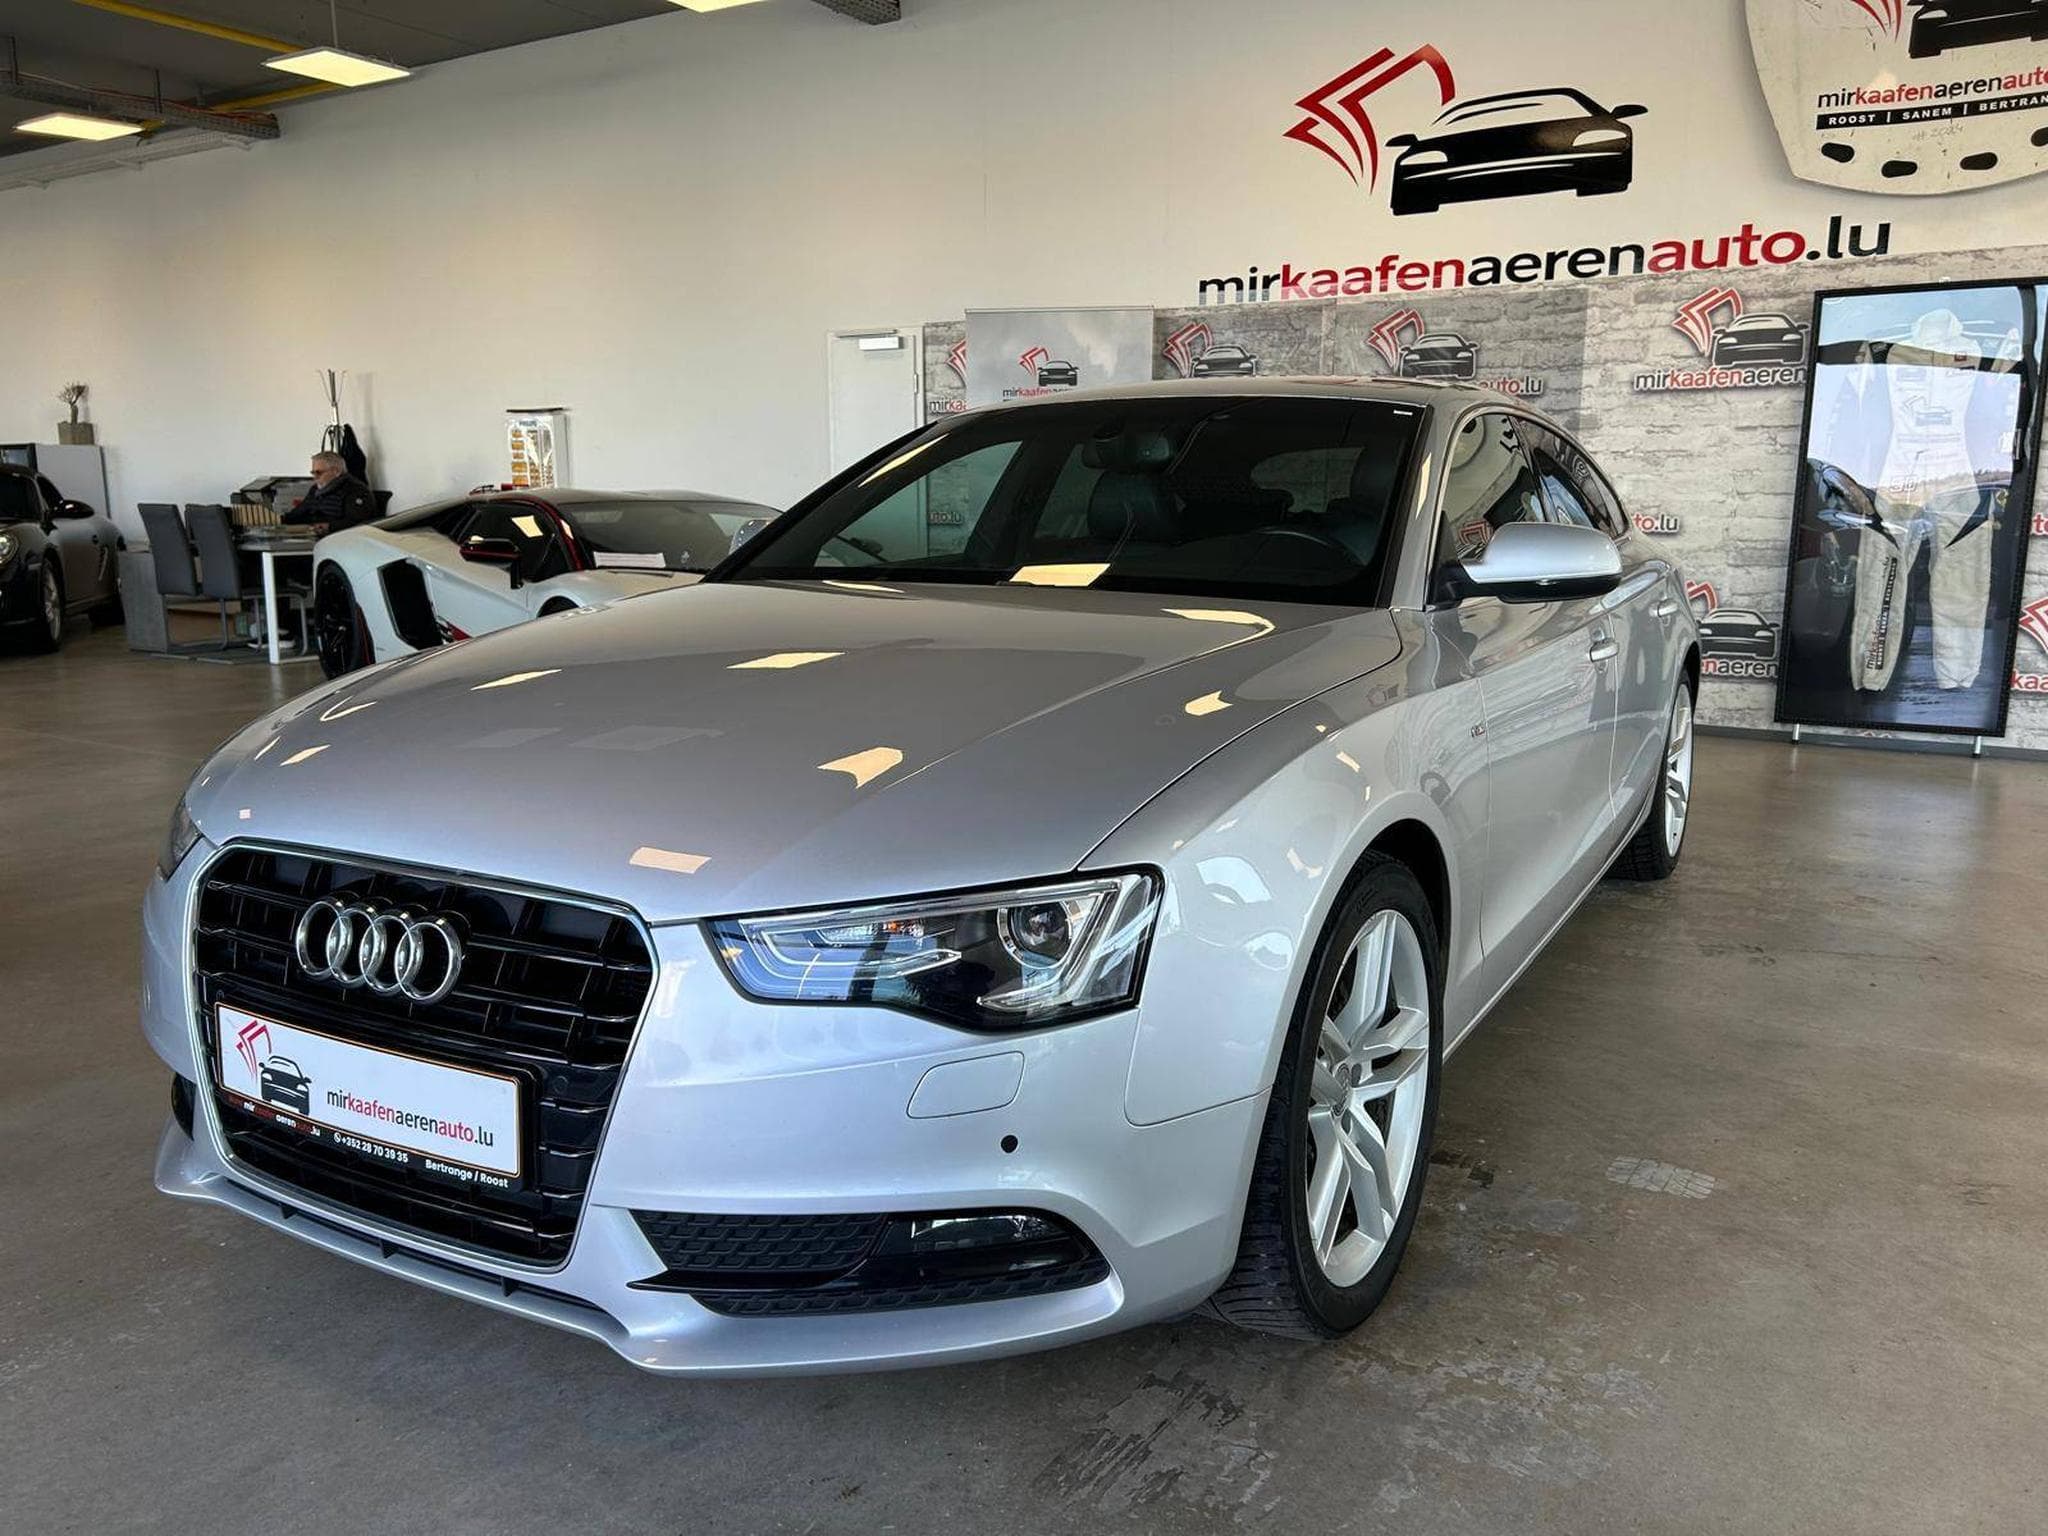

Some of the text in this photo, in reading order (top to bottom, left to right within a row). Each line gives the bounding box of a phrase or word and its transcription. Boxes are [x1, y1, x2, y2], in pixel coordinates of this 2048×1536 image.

[1829, 113, 1876, 126] ROOST
[1902, 107, 1952, 120] SANEM
[1199, 215, 1891, 305] mirkaafenaerenauto.lu
[1701, 659, 1778, 676] naeren
[327, 1090, 493, 1147] mirkaafenaerenauto.lu
[373, 1144, 384, 1157] 70
[425, 1159, 473, 1181] Bertrange
[480, 1172, 509, 1188] Roost
